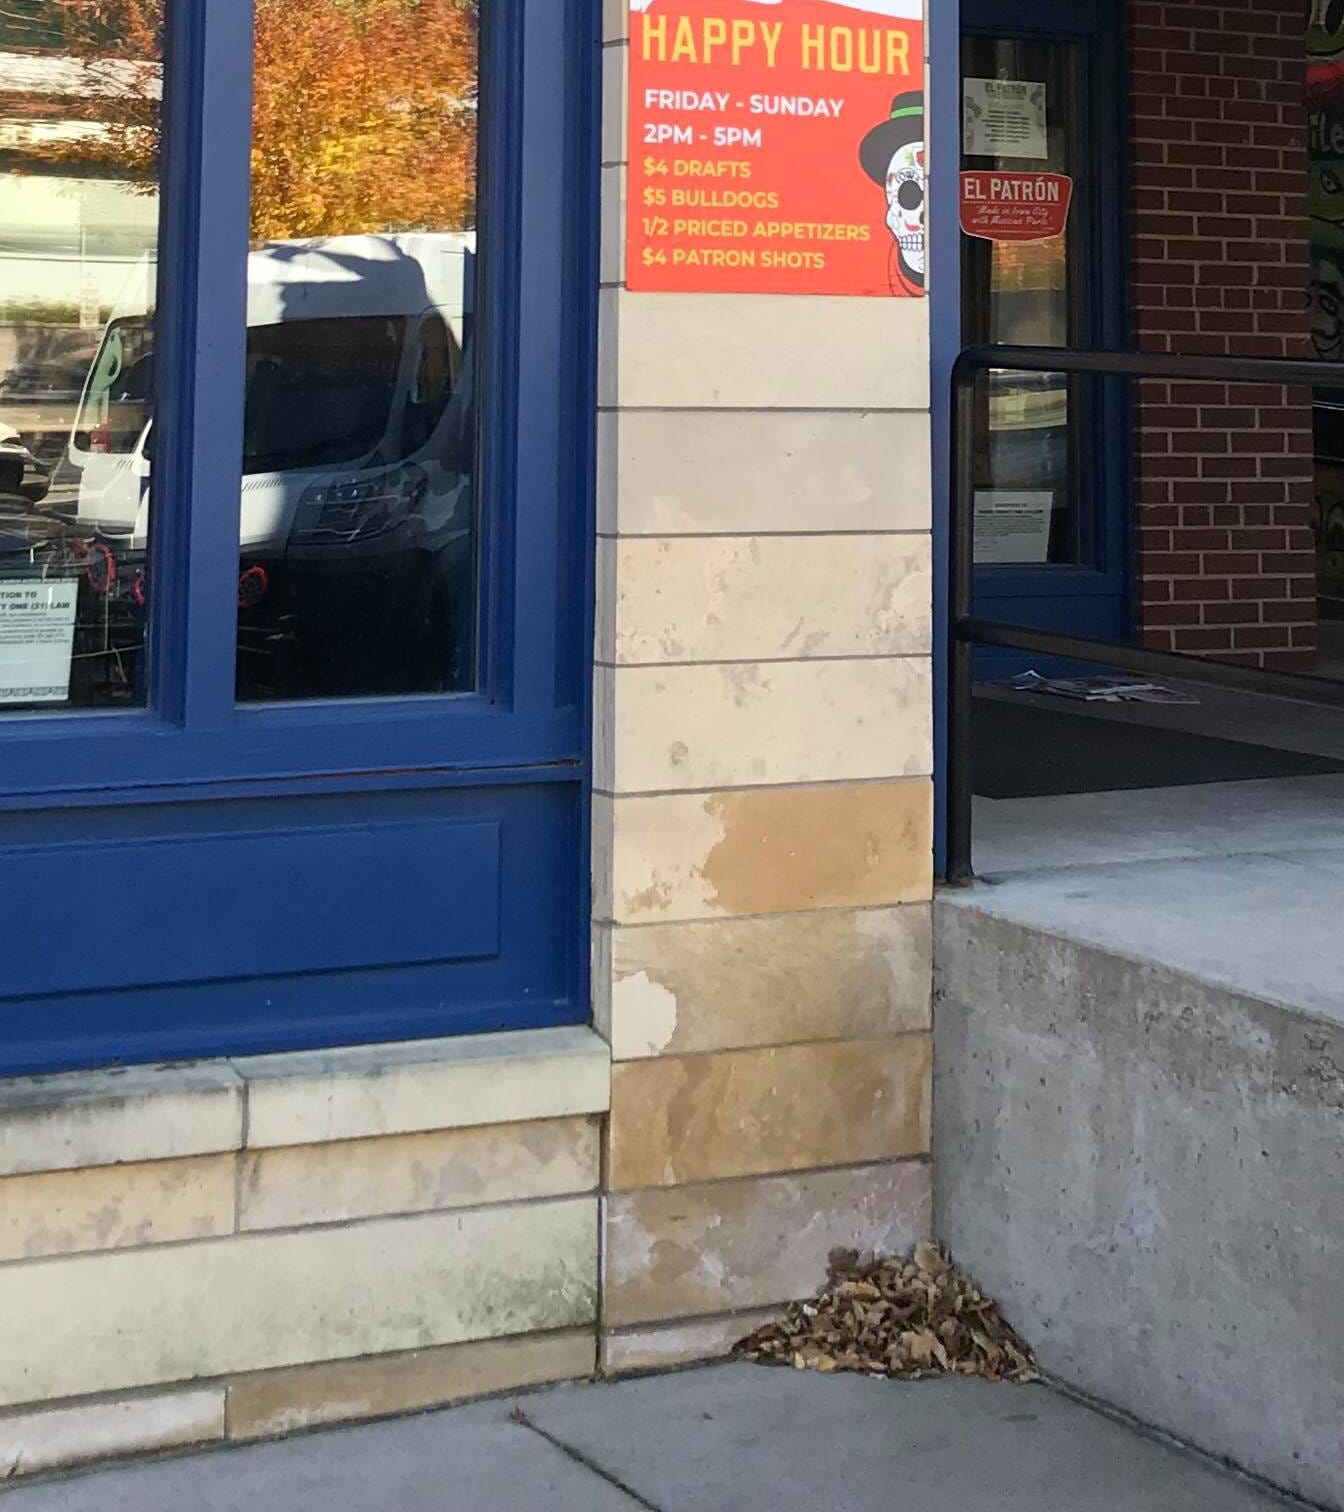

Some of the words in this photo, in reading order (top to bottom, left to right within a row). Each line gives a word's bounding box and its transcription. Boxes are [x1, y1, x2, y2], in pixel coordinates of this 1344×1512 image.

[642, 13, 783, 68] HAPPY
[801, 24, 910, 76] HOUR
[644, 89, 731, 112] FRIDAY
[749, 94, 844, 118] SUNDAY
[643, 124, 693, 145] 2PM
[712, 127, 762, 148] 5PM
[643, 157, 668, 177] $4
[673, 159, 752, 178] DRAFTS
[642, 187, 666, 207] $5
[671, 189, 779, 209] BULLDOGS
[964, 178, 986, 200] EL
[990, 177, 1060, 201] PATRÓN
[642, 216, 668, 236] 1/2
[674, 219, 749, 238] PRICED
[753, 221, 870, 242] APPETIZERS
[641, 247, 667, 267] $4
[673, 249, 756, 268] PATRON
[761, 251, 825, 269] SHOTS
